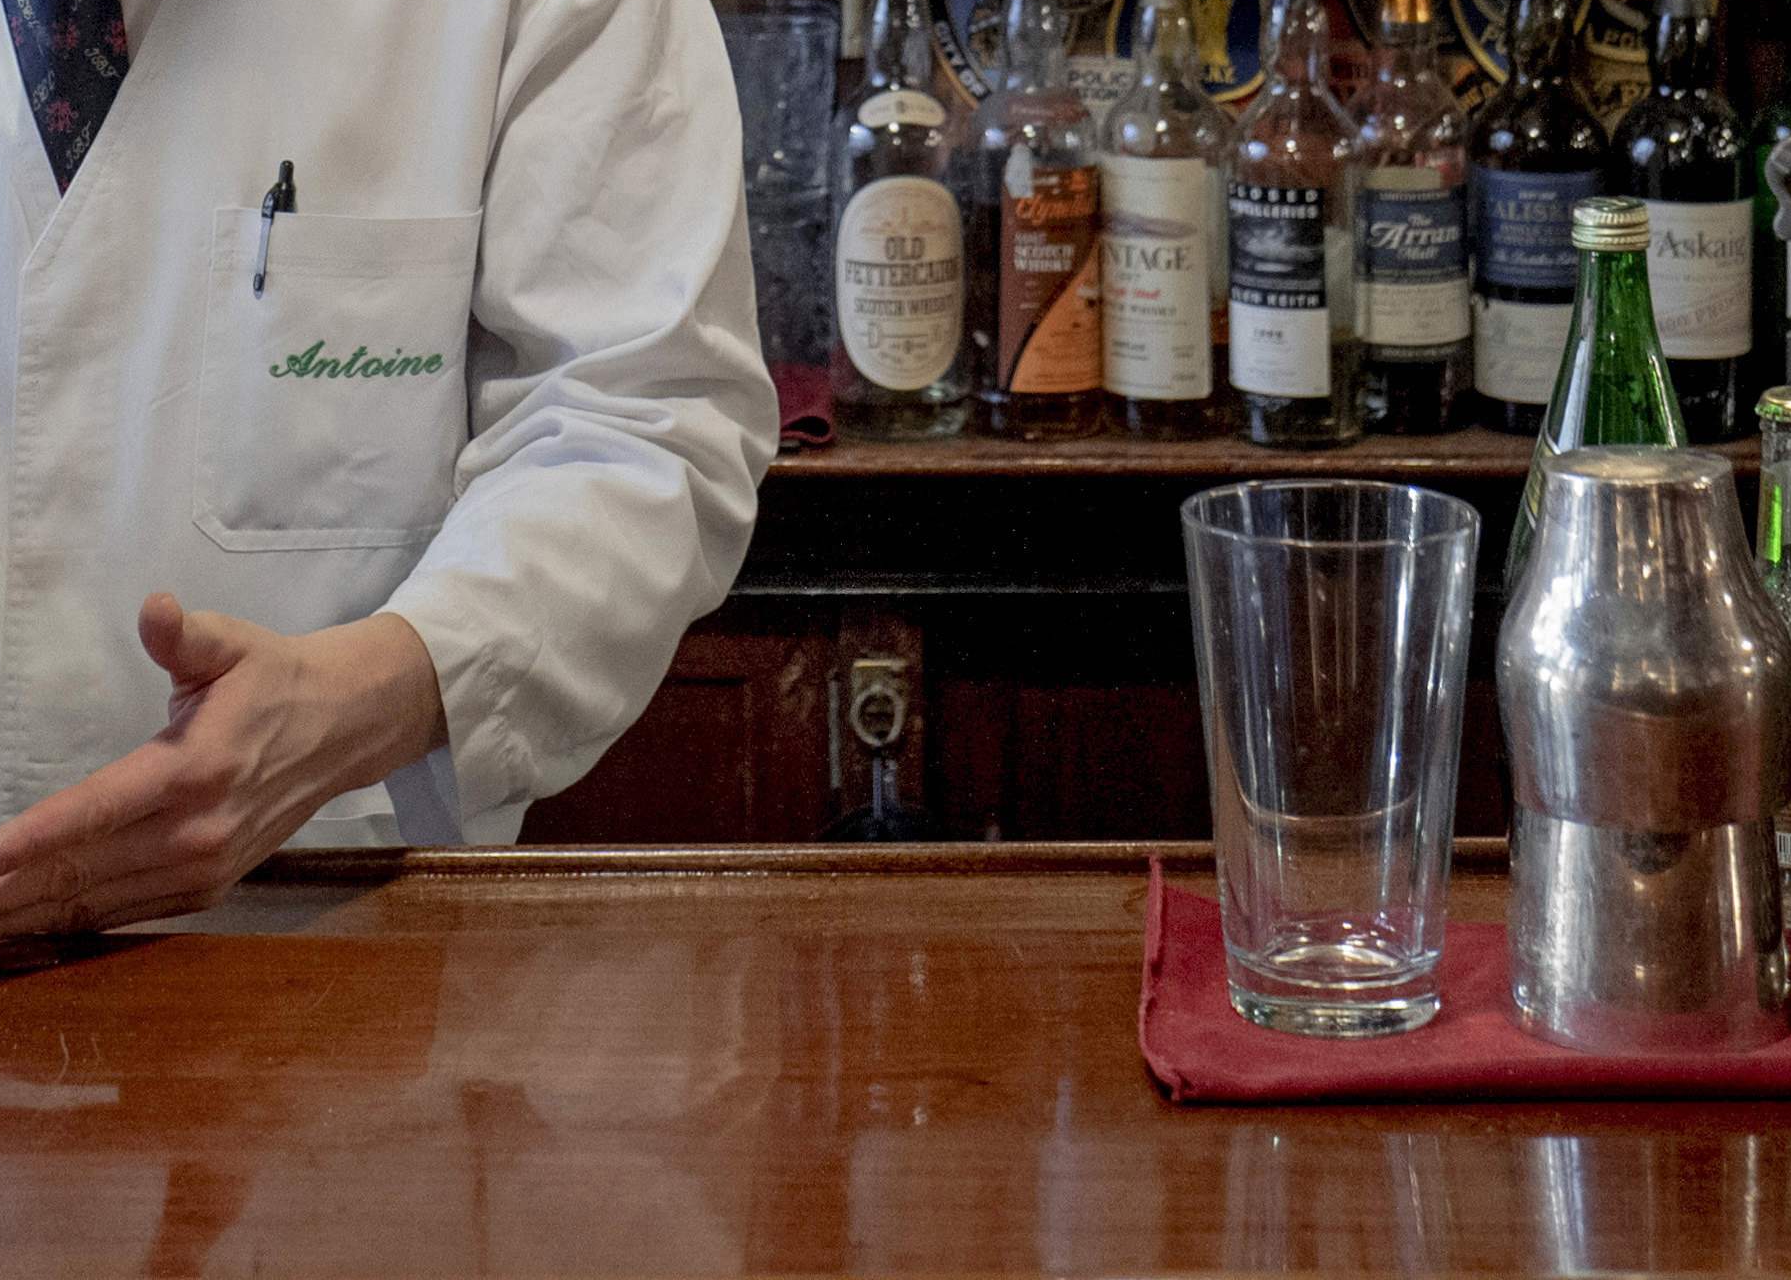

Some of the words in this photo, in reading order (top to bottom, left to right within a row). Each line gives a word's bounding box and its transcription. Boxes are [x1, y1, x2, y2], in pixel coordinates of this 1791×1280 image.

[884, 236, 925, 261] OLD
[1370, 221, 1459, 251] Arran
[1656, 229, 1745, 262] Askaig
[1013, 245, 1073, 259] SCOTCH
[269, 339, 444, 379] Antoine
